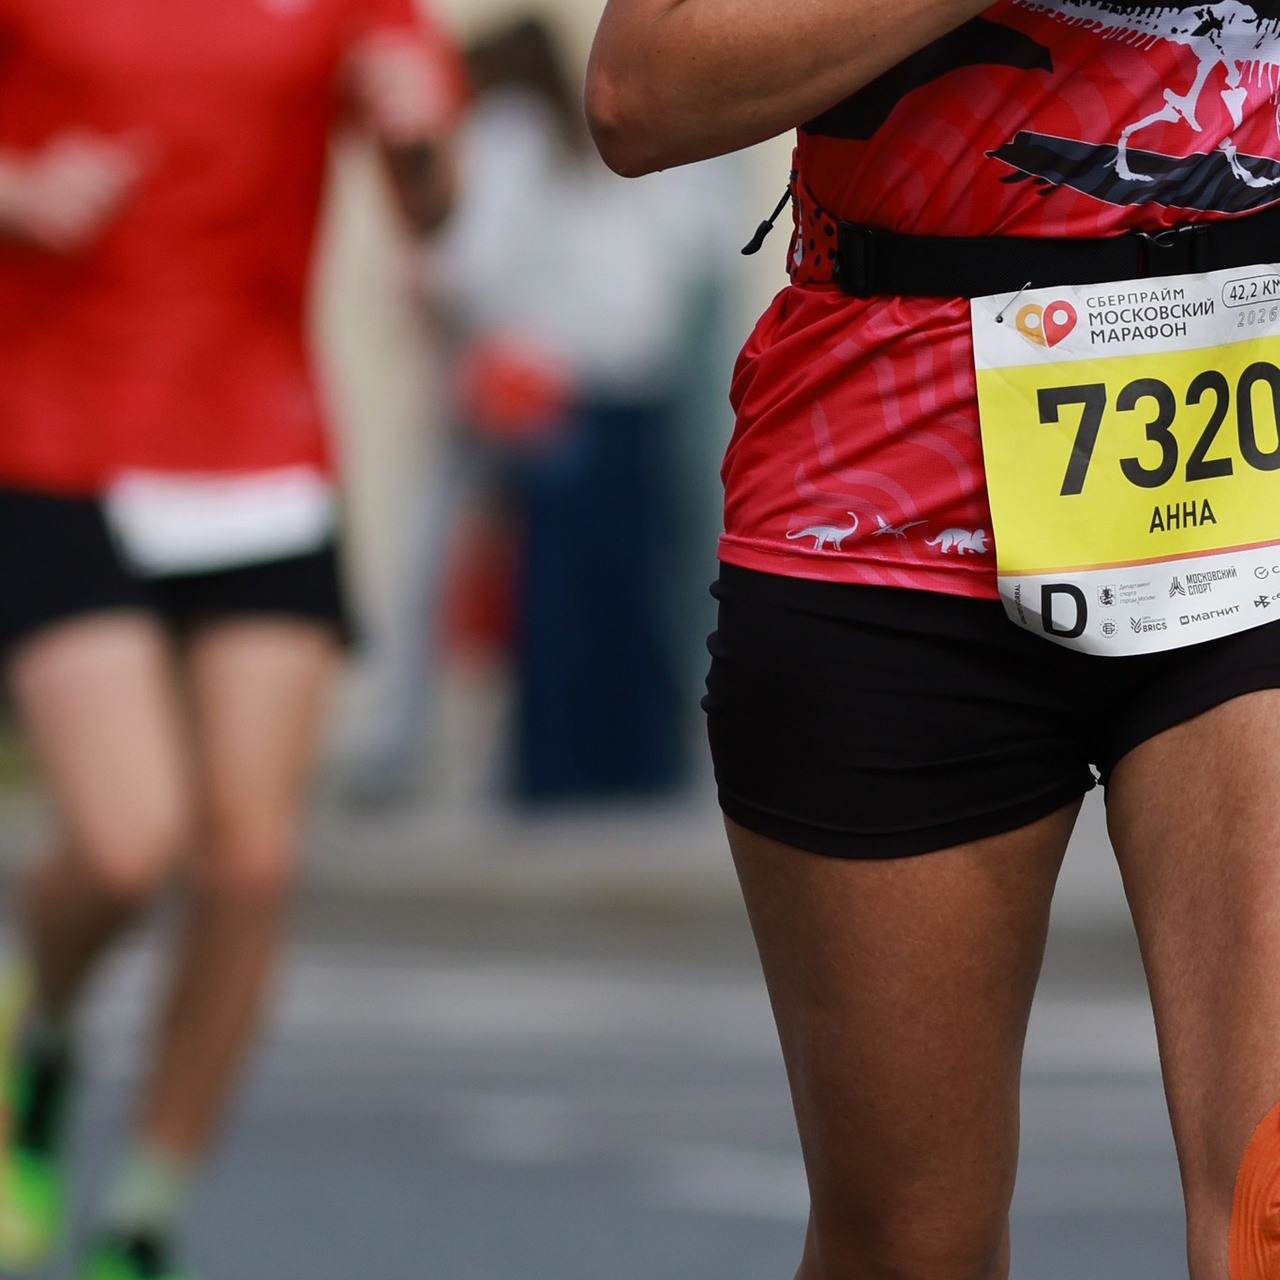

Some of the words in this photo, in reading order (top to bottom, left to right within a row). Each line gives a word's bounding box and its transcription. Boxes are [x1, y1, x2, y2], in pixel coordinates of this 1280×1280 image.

[1086, 288, 1185, 309] СБЕРПРАЙМ
[1229, 282, 1258, 302] 42,2
[1088, 298, 1215, 327] МОСКОВСКИЙ
[1090, 322, 1188, 345] МАРАФОН
[1148, 498, 1218, 534] АННА
[1186, 566, 1238, 584] МОСКОВСКИЙ
[1187, 582, 1213, 596] СПОРТ
[1041, 583, 1088, 639] D
[1142, 622, 1168, 633] BRICS
